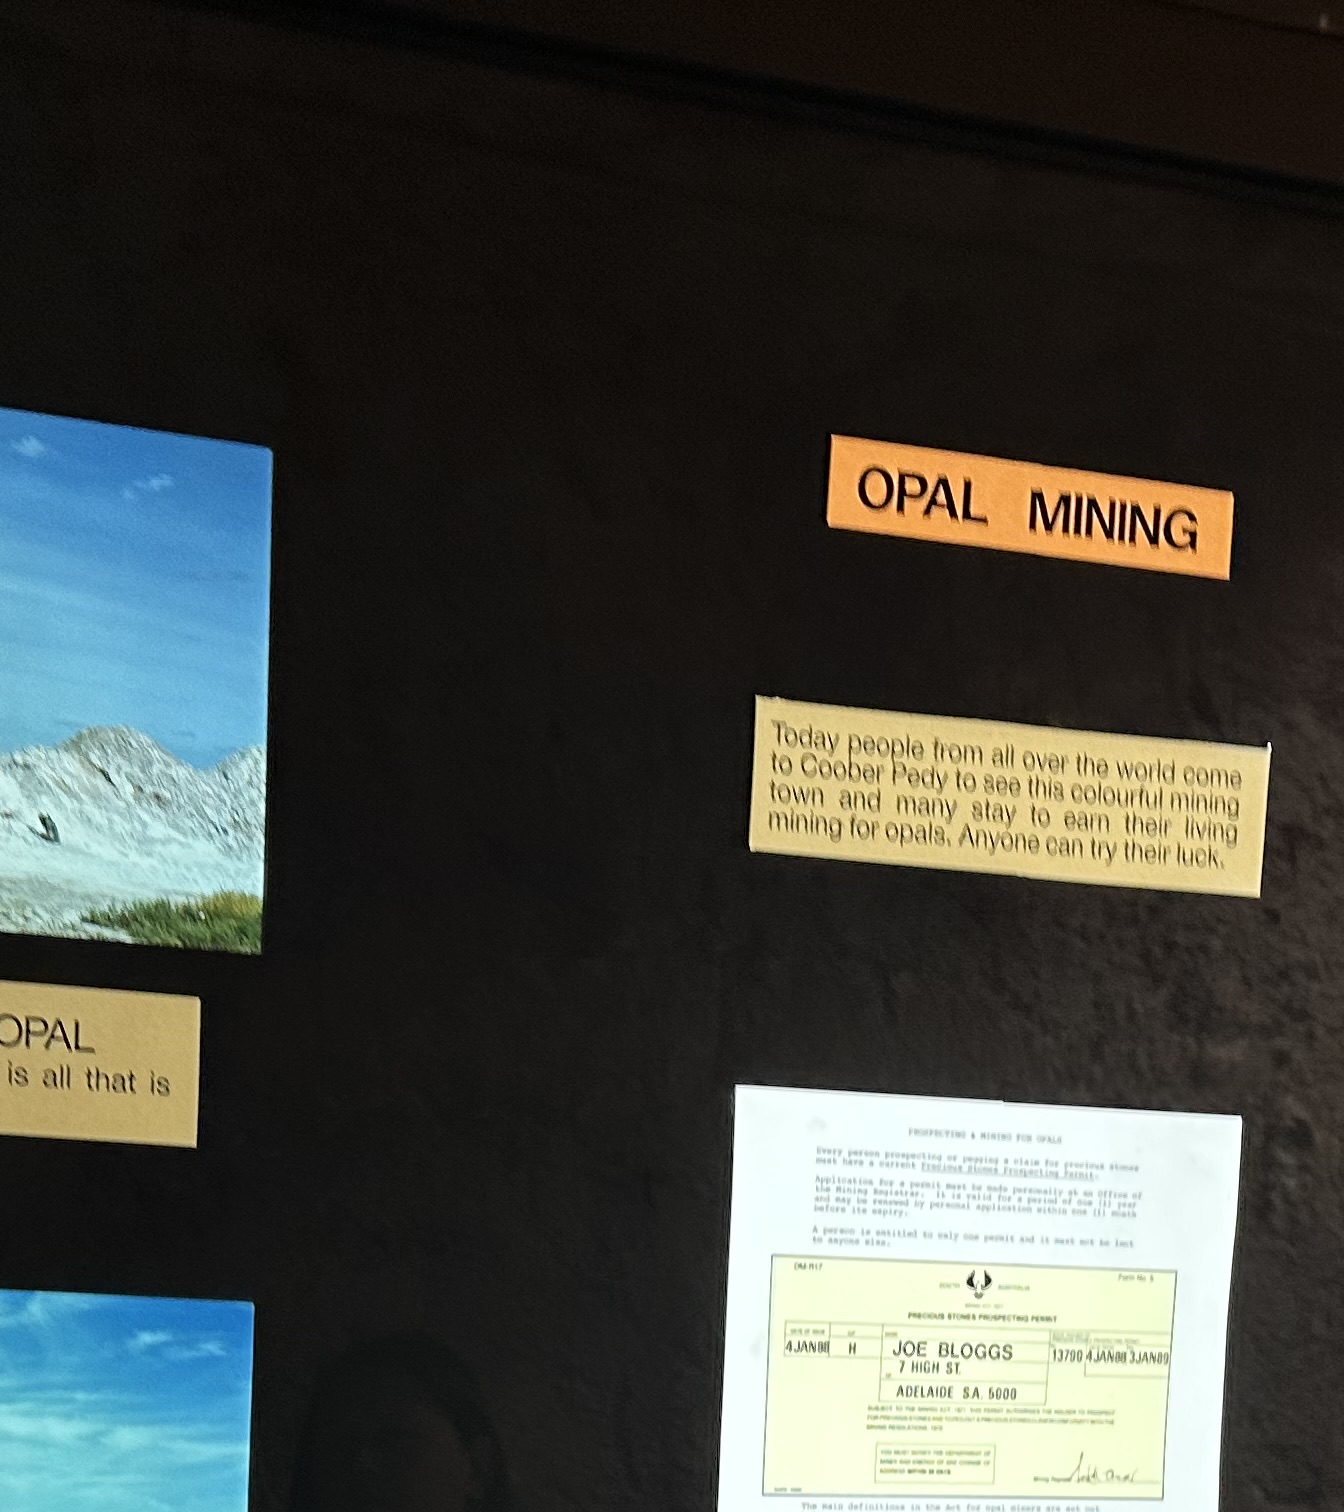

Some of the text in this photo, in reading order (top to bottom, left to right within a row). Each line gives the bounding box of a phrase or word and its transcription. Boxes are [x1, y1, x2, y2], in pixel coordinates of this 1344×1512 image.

[857, 467, 1198, 550] OPAL MINING
[772, 721, 1242, 789] Today people from all over the world come
[7, 1060, 28, 1087] is
[42, 1064, 71, 1090] all
[86, 1066, 135, 1094] that
[150, 1070, 170, 1096] is
[892, 1339, 1013, 1361] JOE BLOGGS
